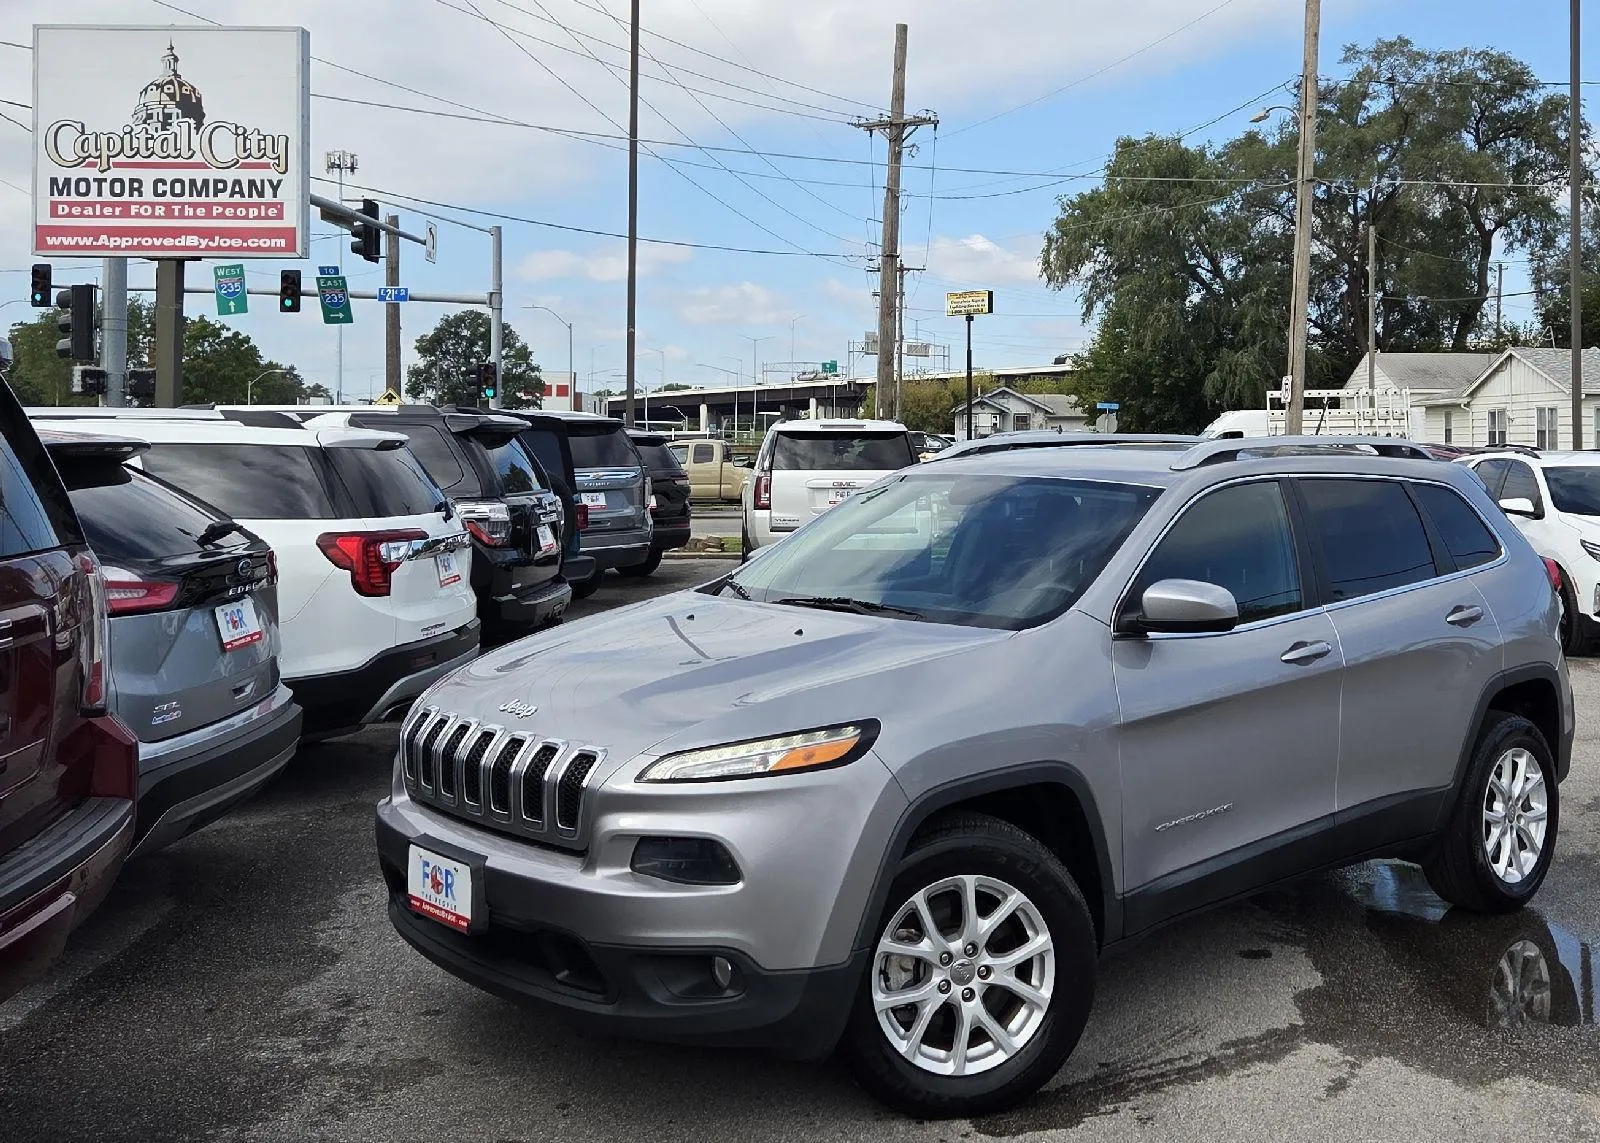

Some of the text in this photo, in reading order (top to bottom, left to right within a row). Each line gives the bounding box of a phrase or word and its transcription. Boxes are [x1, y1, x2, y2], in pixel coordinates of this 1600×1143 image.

[45, 119, 290, 175] Capital City
[49, 177, 284, 199] MOTOR COMPANY
[57, 204, 278, 219] Dealer FOR The People
[46, 234, 286, 250] www.ApprovedByJoe.com
[216, 268, 241, 276] WEST
[220, 283, 241, 294] 235
[320, 279, 343, 287] EAST
[324, 293, 345, 303] 235
[224, 608, 248, 633] FOR
[498, 699, 538, 719] Jeep
[1155, 803, 1232, 832] CHEROKEE
[422, 860, 457, 901] FOR
